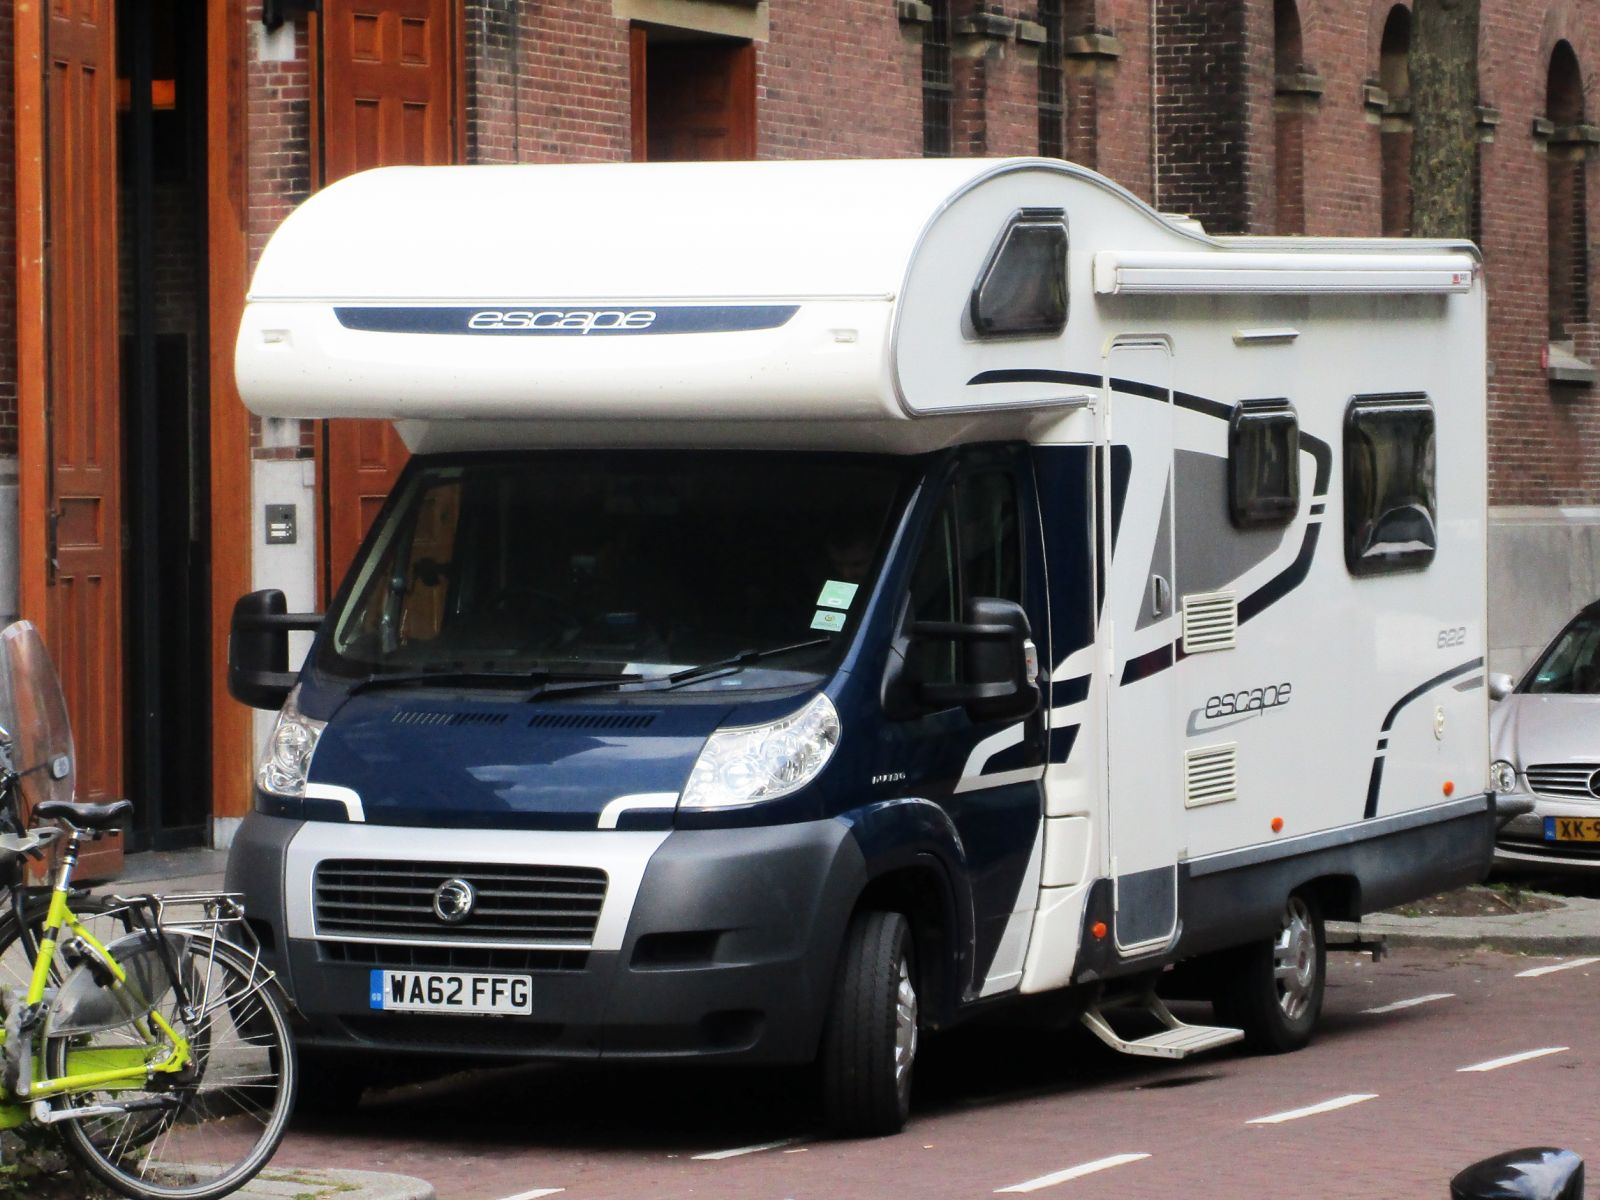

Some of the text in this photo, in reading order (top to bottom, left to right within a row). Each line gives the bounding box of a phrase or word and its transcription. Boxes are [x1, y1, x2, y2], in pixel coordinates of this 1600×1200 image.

[468, 311, 657, 335] escape
[1437, 626, 1466, 649] 622
[1205, 682, 1292, 719] escape
[390, 974, 528, 1008] WA62 FFG
